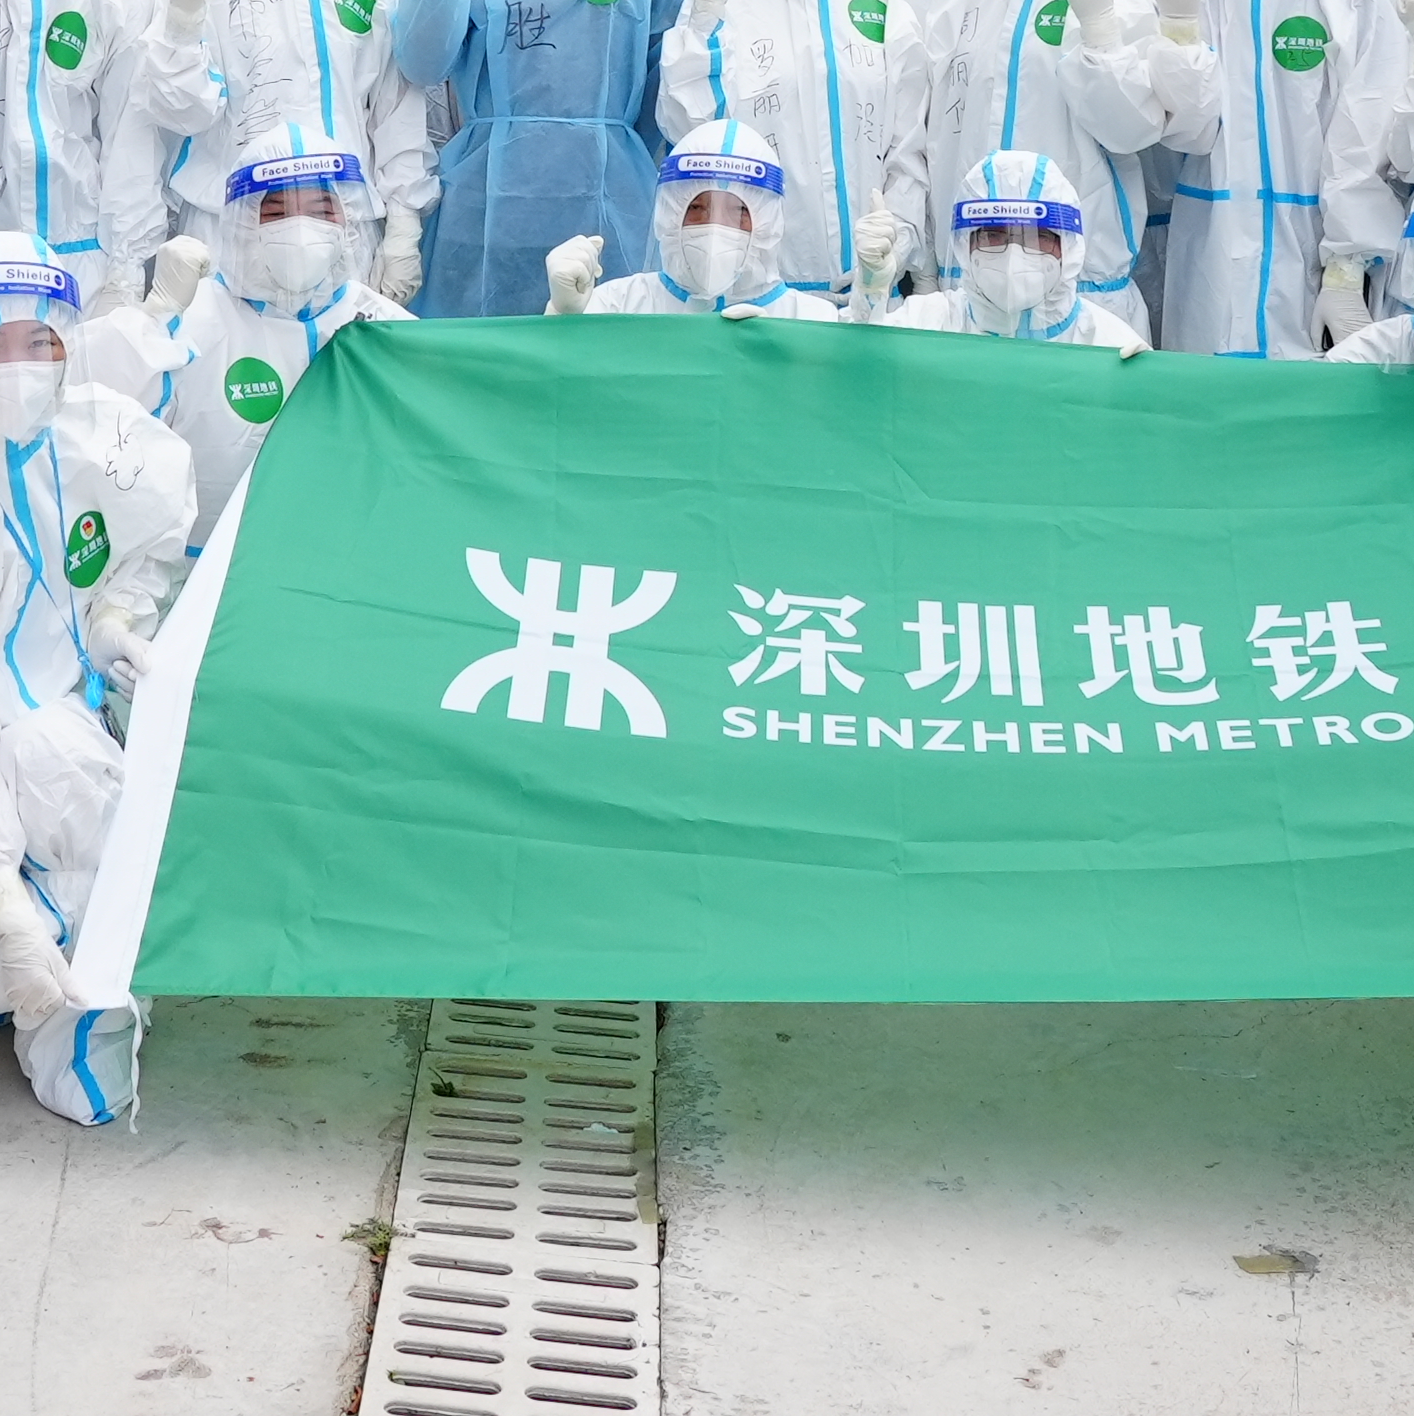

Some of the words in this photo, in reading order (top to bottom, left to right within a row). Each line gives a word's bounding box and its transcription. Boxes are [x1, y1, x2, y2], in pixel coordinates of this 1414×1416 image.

[1287, 36, 1323, 46] 深圳地铁
[261, 165, 288, 177] Face
[293, 160, 330, 172] Shield
[686, 159, 711, 169] Face
[714, 160, 751, 174] Shield
[967, 206, 989, 216] Face
[992, 204, 1029, 217] Shield
[6, 269, 51, 282] Shield
[243, 380, 278, 393] 深圳地铁
[727, 583, 1399, 706] 深圳地铁
[722, 706, 1123, 754] SHENZHEN
[1155, 712, 1414, 753] METRO
